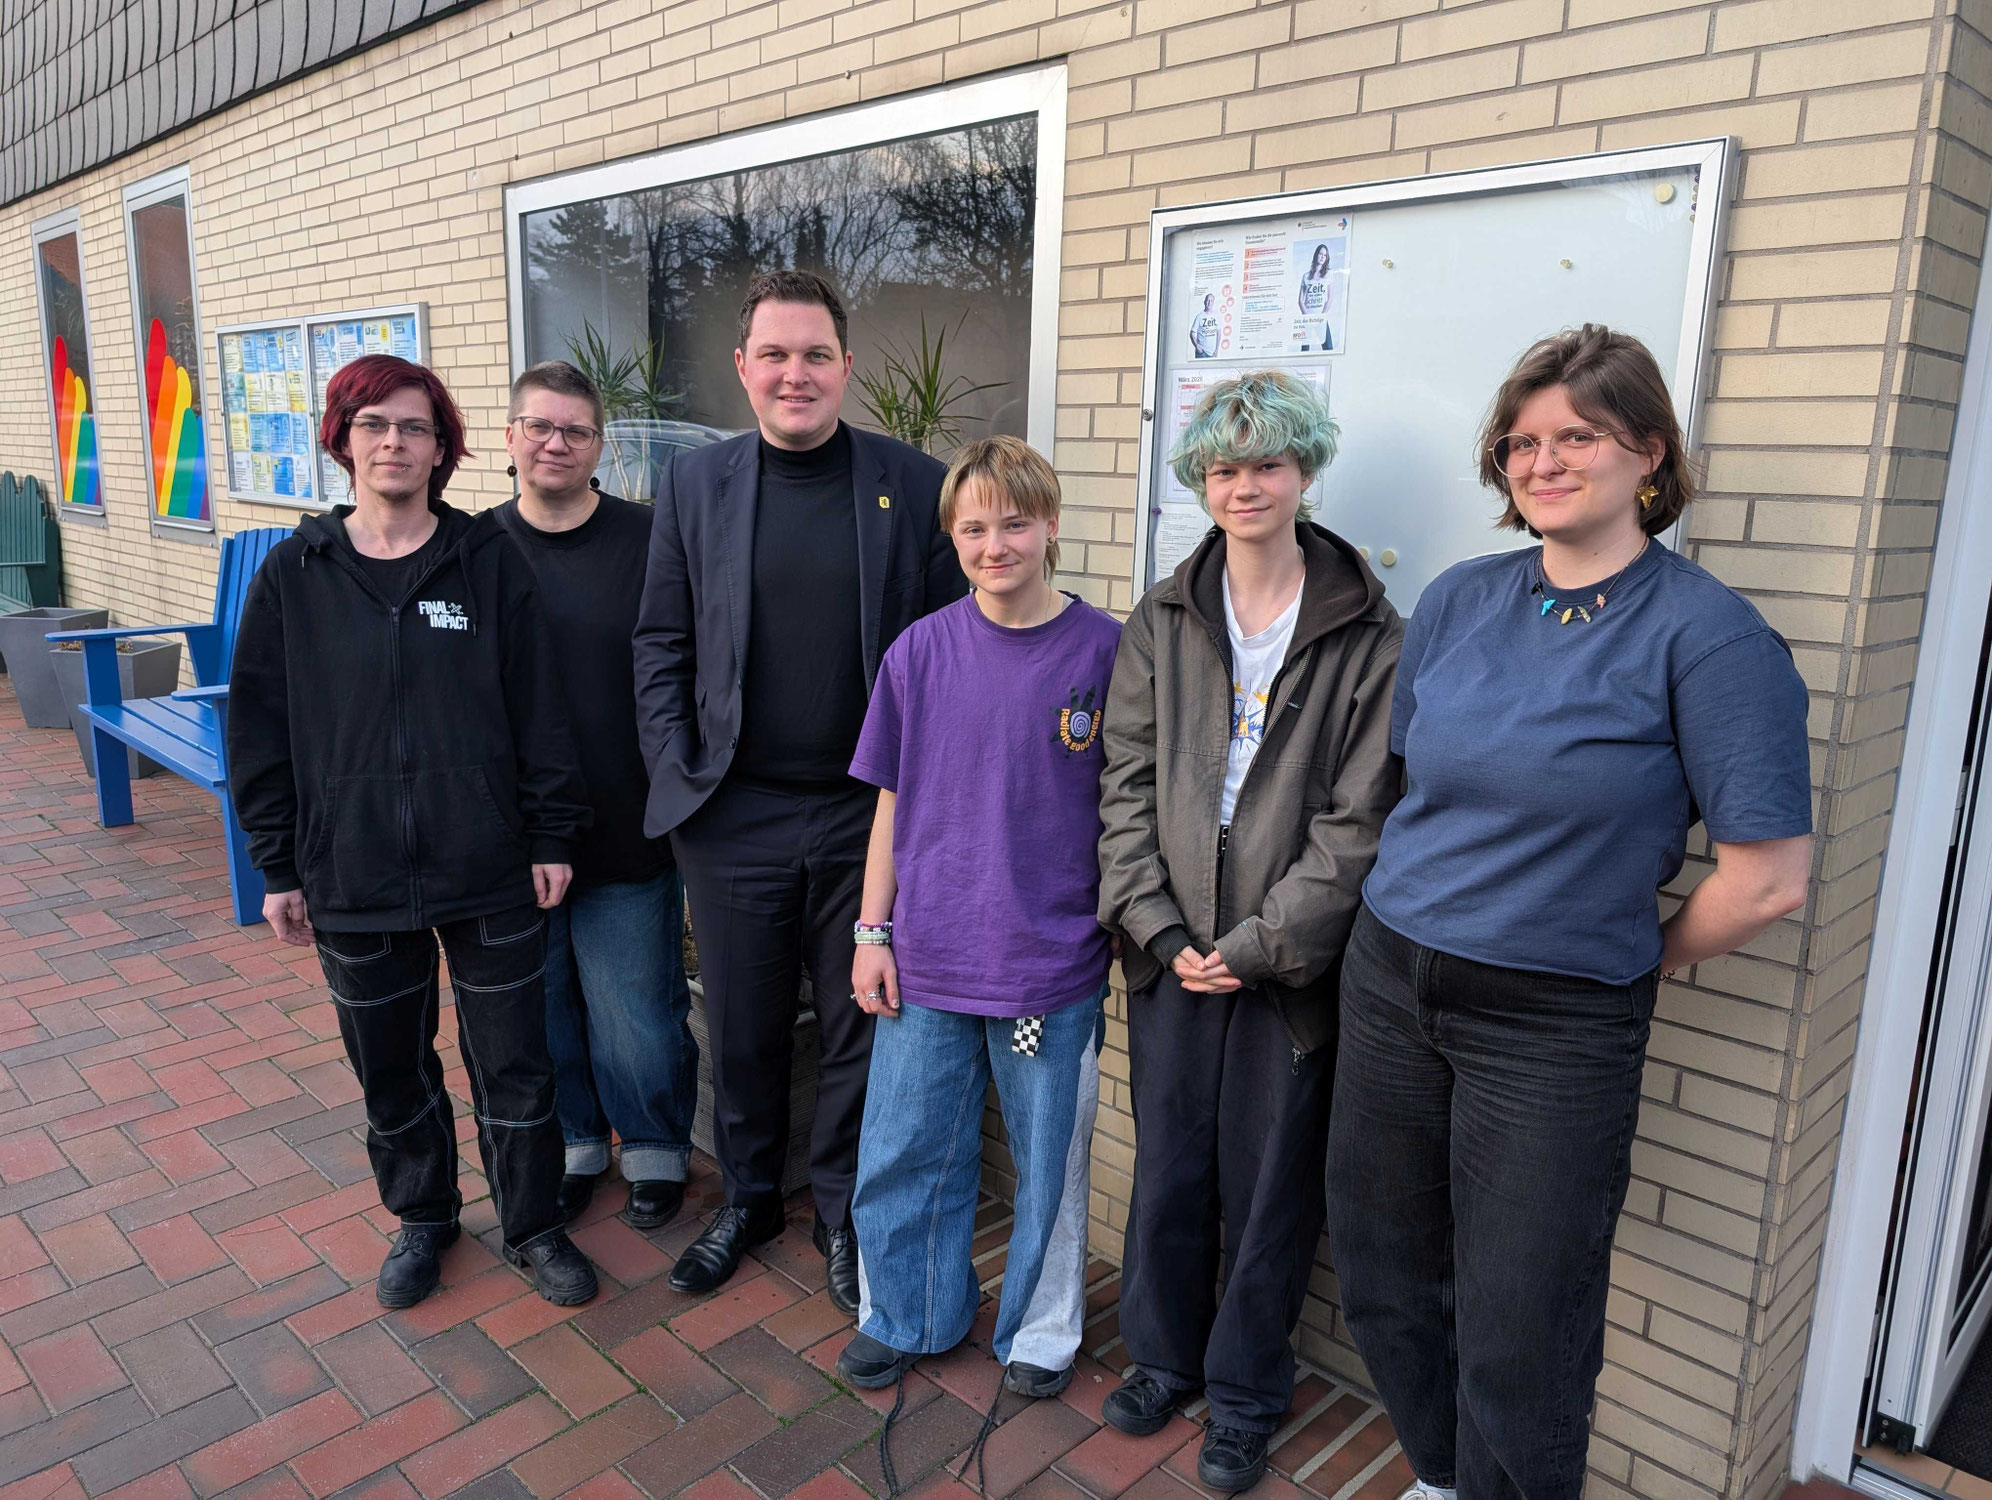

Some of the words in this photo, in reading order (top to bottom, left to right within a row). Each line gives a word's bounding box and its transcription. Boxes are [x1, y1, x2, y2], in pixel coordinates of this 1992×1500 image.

[1307, 282, 1326, 294] Zeit,
[418, 600, 450, 615] FINAL
[430, 614, 469, 631] IMPACT
[1060, 708, 1071, 746] Radiate
[1070, 738, 1090, 752] good
[1089, 709, 1101, 742] energy
